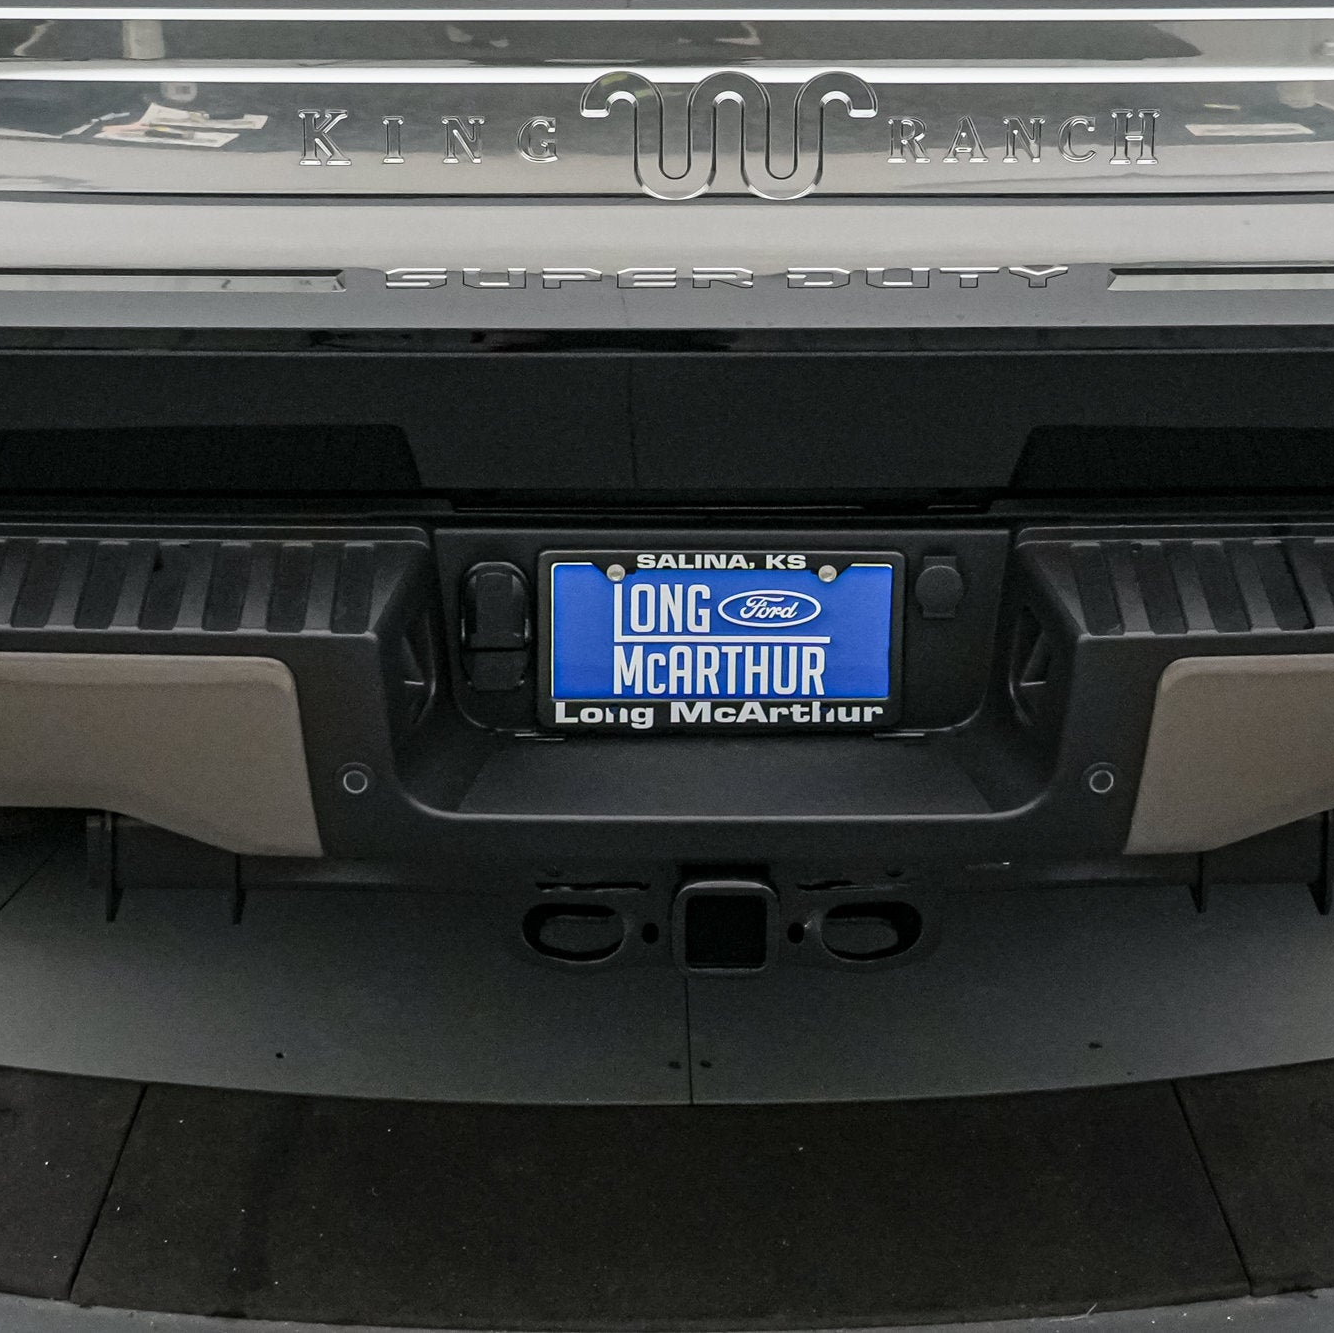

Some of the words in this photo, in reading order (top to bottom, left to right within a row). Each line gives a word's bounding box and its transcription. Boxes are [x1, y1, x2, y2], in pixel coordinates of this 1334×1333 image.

[298, 109, 559, 166] KING
[886, 109, 1160, 165] RANCH
[385, 266, 754, 289] SUPER
[787, 266, 1068, 288] DUTY
[636, 554, 756, 570] SALINA,
[766, 554, 807, 569] KS
[614, 583, 711, 642] LONG
[739, 596, 798, 619] Ford
[613, 645, 825, 696] McARTHUR
[555, 702, 654, 729] Long
[670, 702, 884, 724] McArthur
